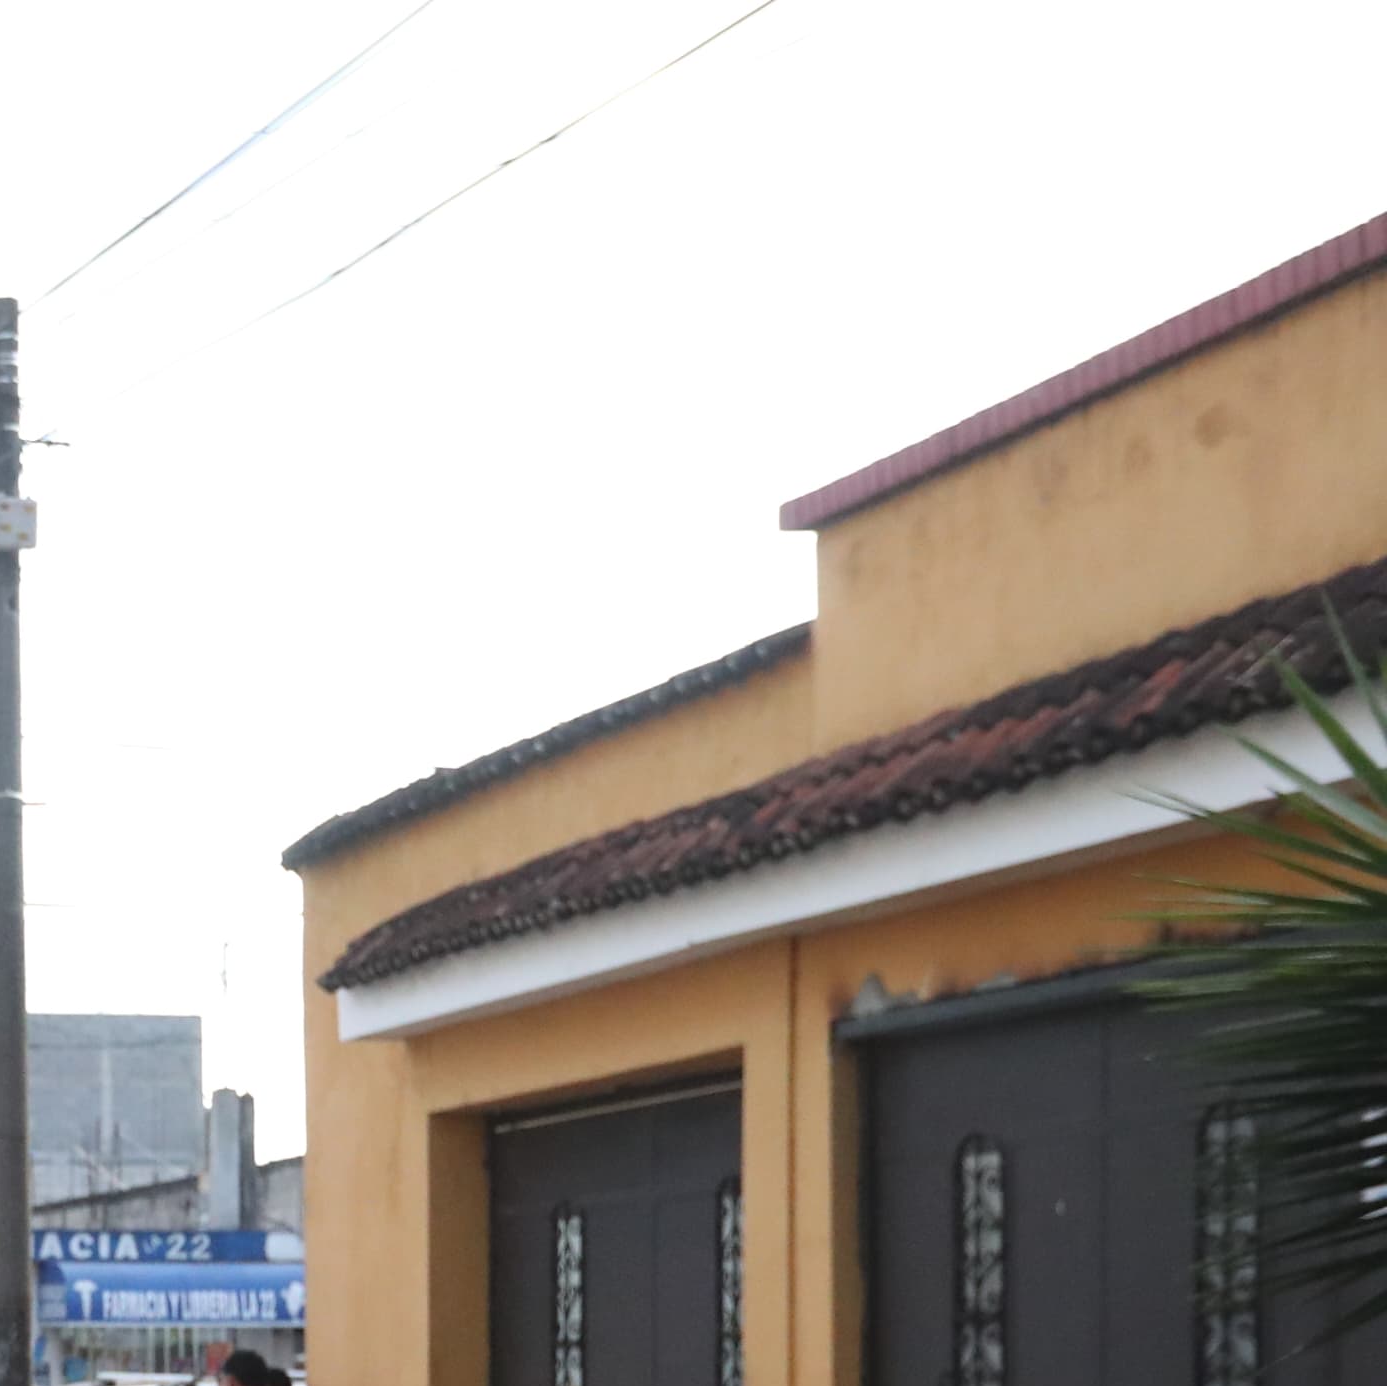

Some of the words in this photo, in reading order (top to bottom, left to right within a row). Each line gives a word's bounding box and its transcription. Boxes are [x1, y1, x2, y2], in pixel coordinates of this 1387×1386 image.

[165, 1233, 210, 1261] 22
[102, 1290, 167, 1319] FARMACIA
[168, 1290, 180, 1319] Y
[181, 1290, 238, 1319] LIBRERIA
[240, 1290, 259, 1319] LA
